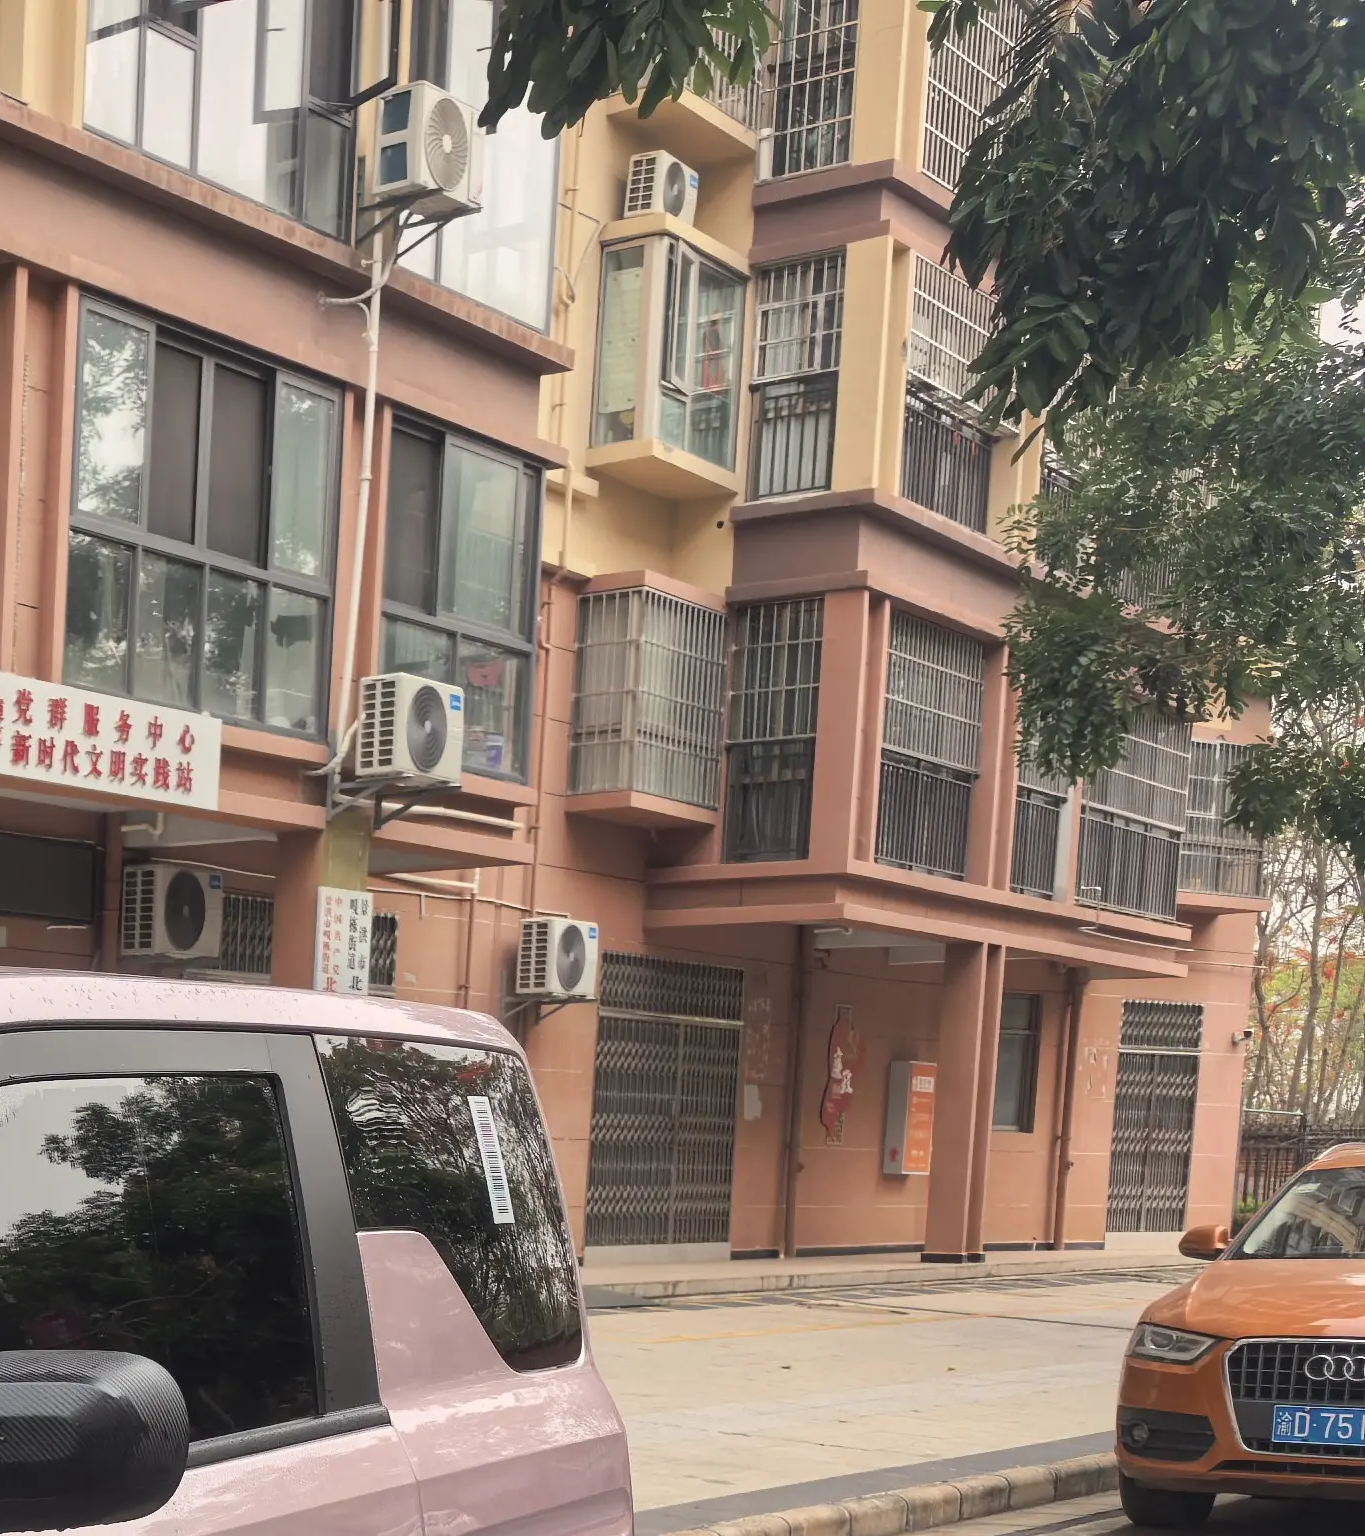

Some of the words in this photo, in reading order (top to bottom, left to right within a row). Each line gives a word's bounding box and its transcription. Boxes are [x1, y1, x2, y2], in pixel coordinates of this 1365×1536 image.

[12, 688, 196, 754] 党群服务中心
[10, 730, 194, 794] 新时代文明实践站
[1276, 1411, 1365, 1440] 渝D·75
